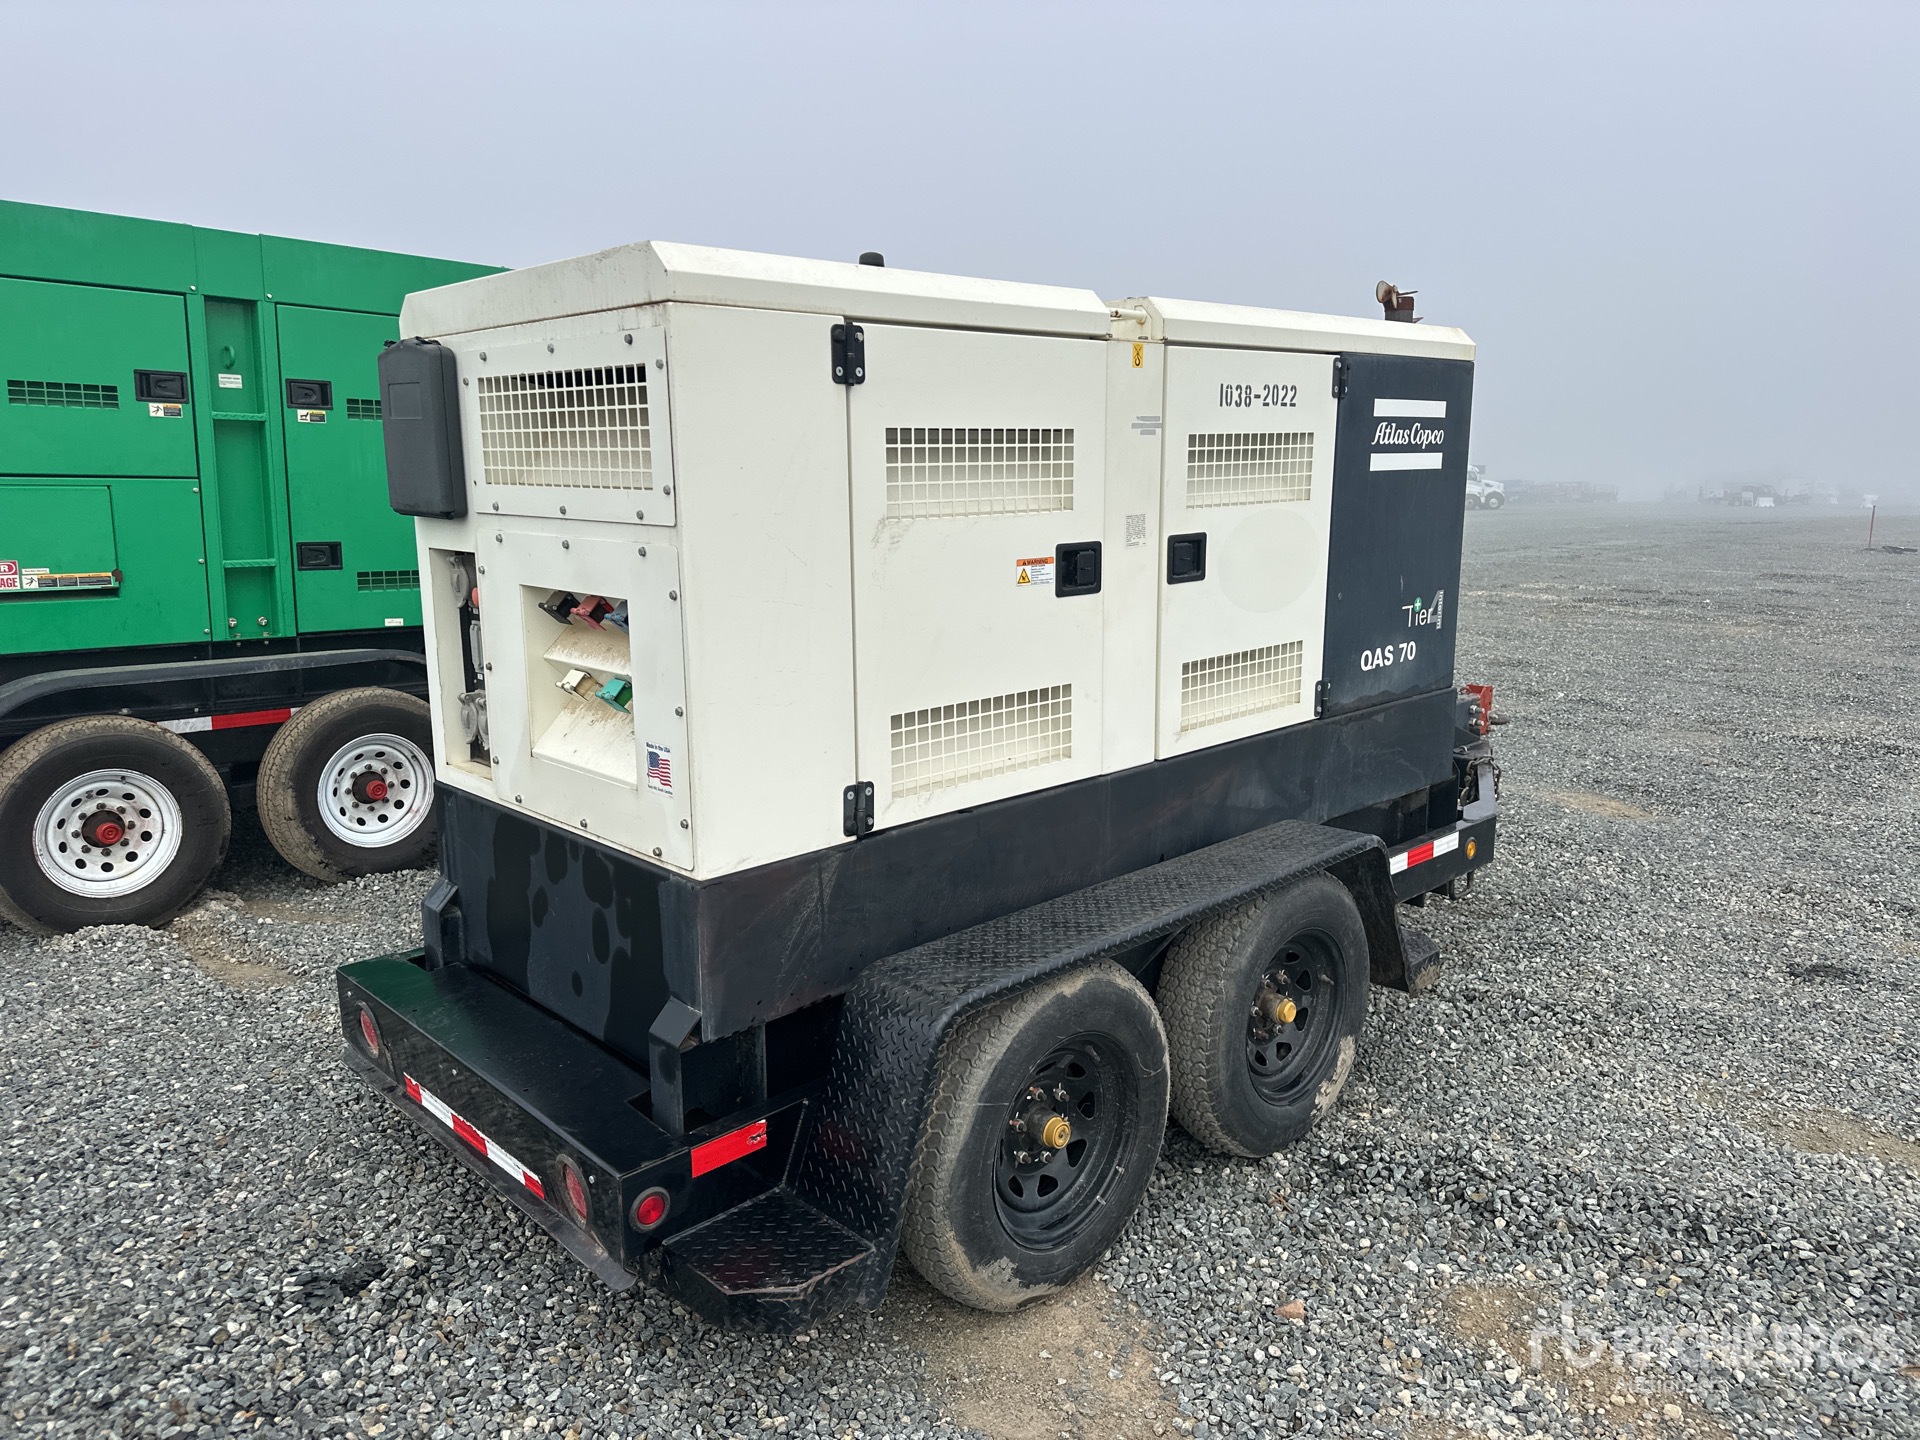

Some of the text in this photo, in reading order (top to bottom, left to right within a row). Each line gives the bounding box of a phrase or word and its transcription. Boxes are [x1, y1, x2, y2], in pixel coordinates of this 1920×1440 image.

[1219, 383, 1298, 408] 1038-2022
[1026, 557, 1049, 566] WARNING
[1360, 640, 1417, 672] QAS 70
